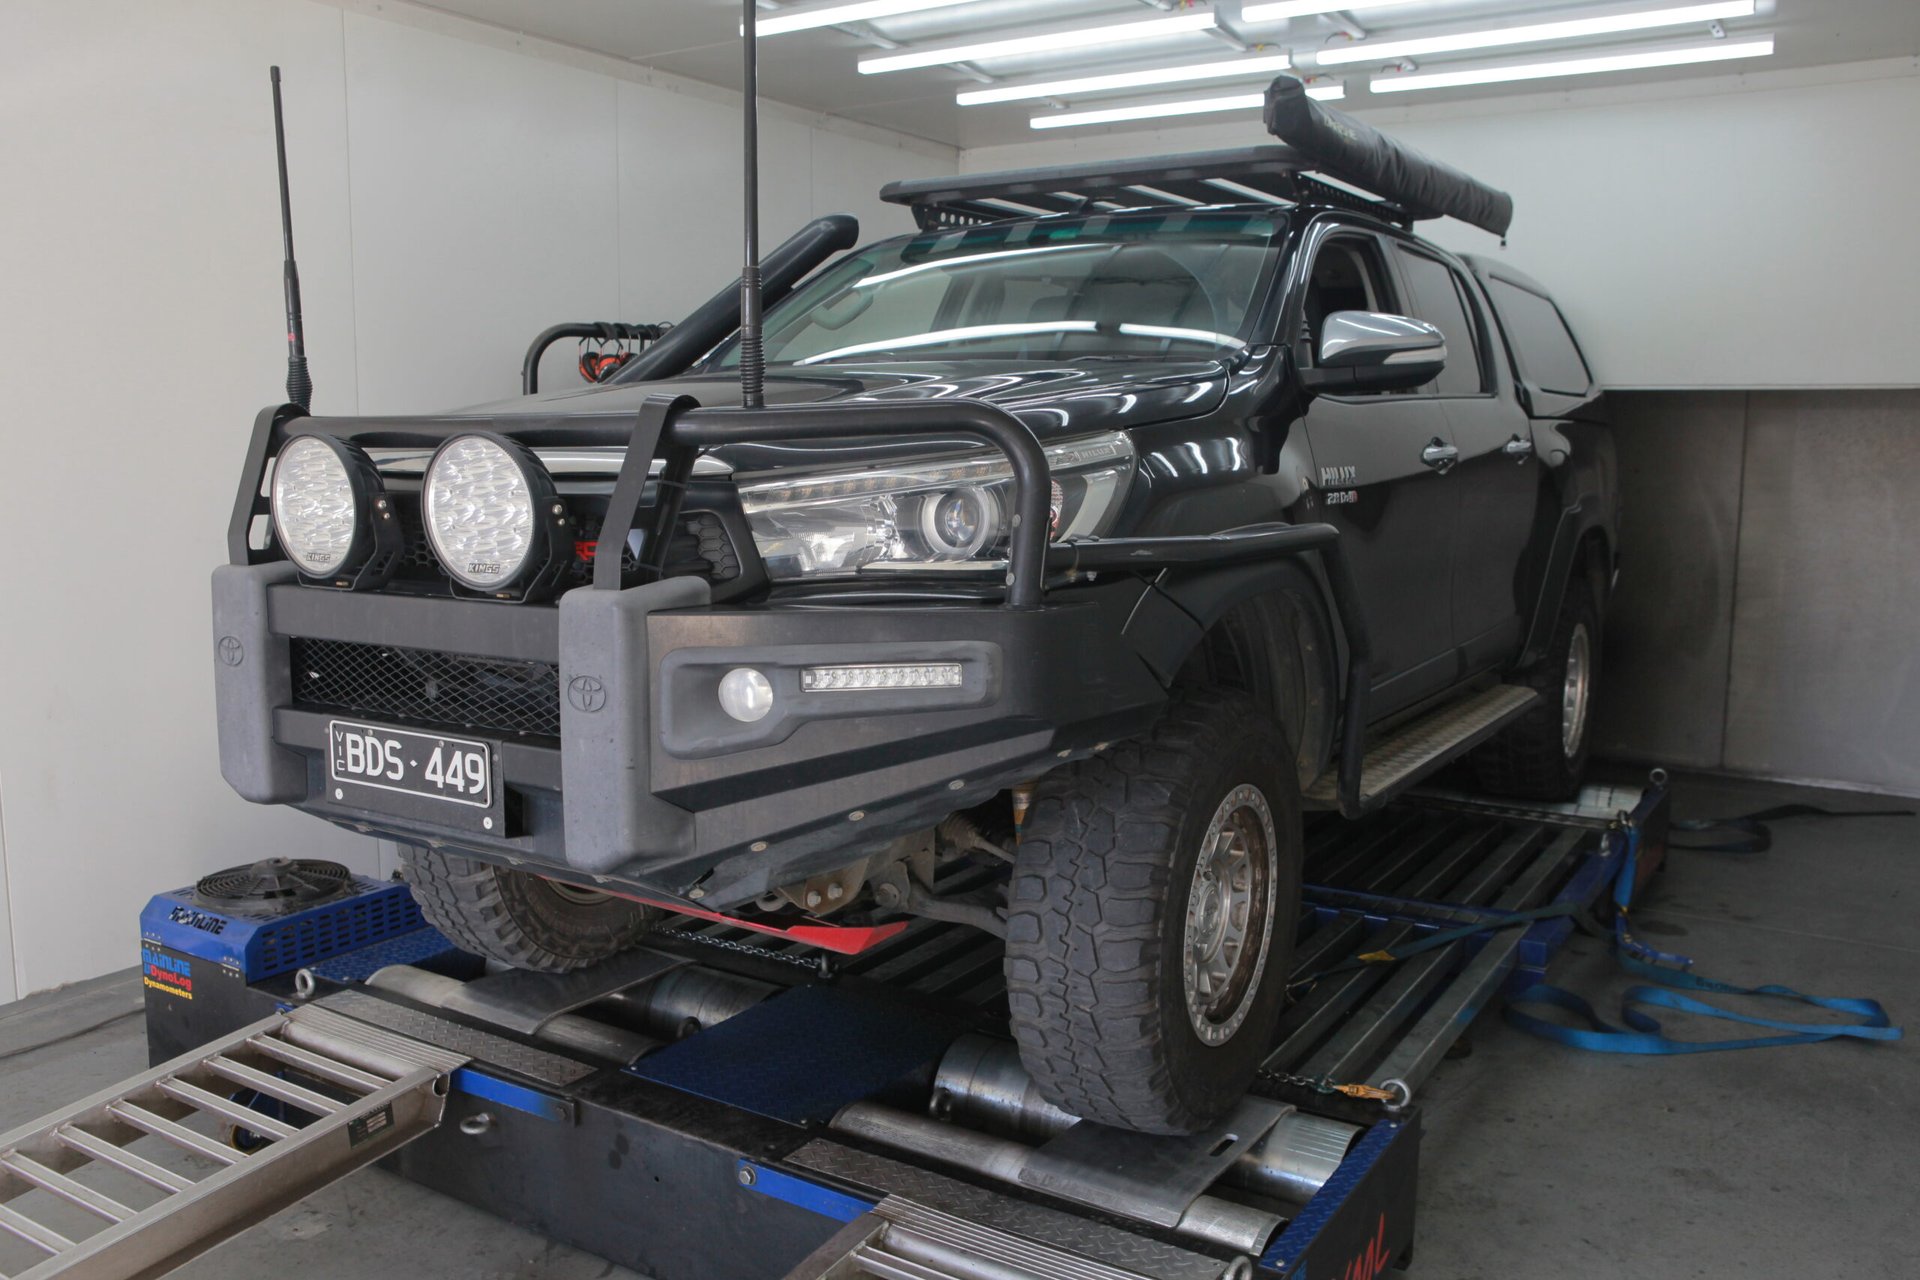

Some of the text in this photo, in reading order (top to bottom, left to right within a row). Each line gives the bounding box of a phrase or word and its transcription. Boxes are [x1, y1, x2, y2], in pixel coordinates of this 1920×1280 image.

[1321, 465, 1356, 486] HILUX
[306, 552, 331, 563] KINGS
[468, 563, 501, 575] KINGS
[335, 731, 345, 771] VIC
[346, 732, 486, 795] BDS 449
[143, 976, 193, 1000] Dynamometers
[150, 964, 192, 991] DynoLog
